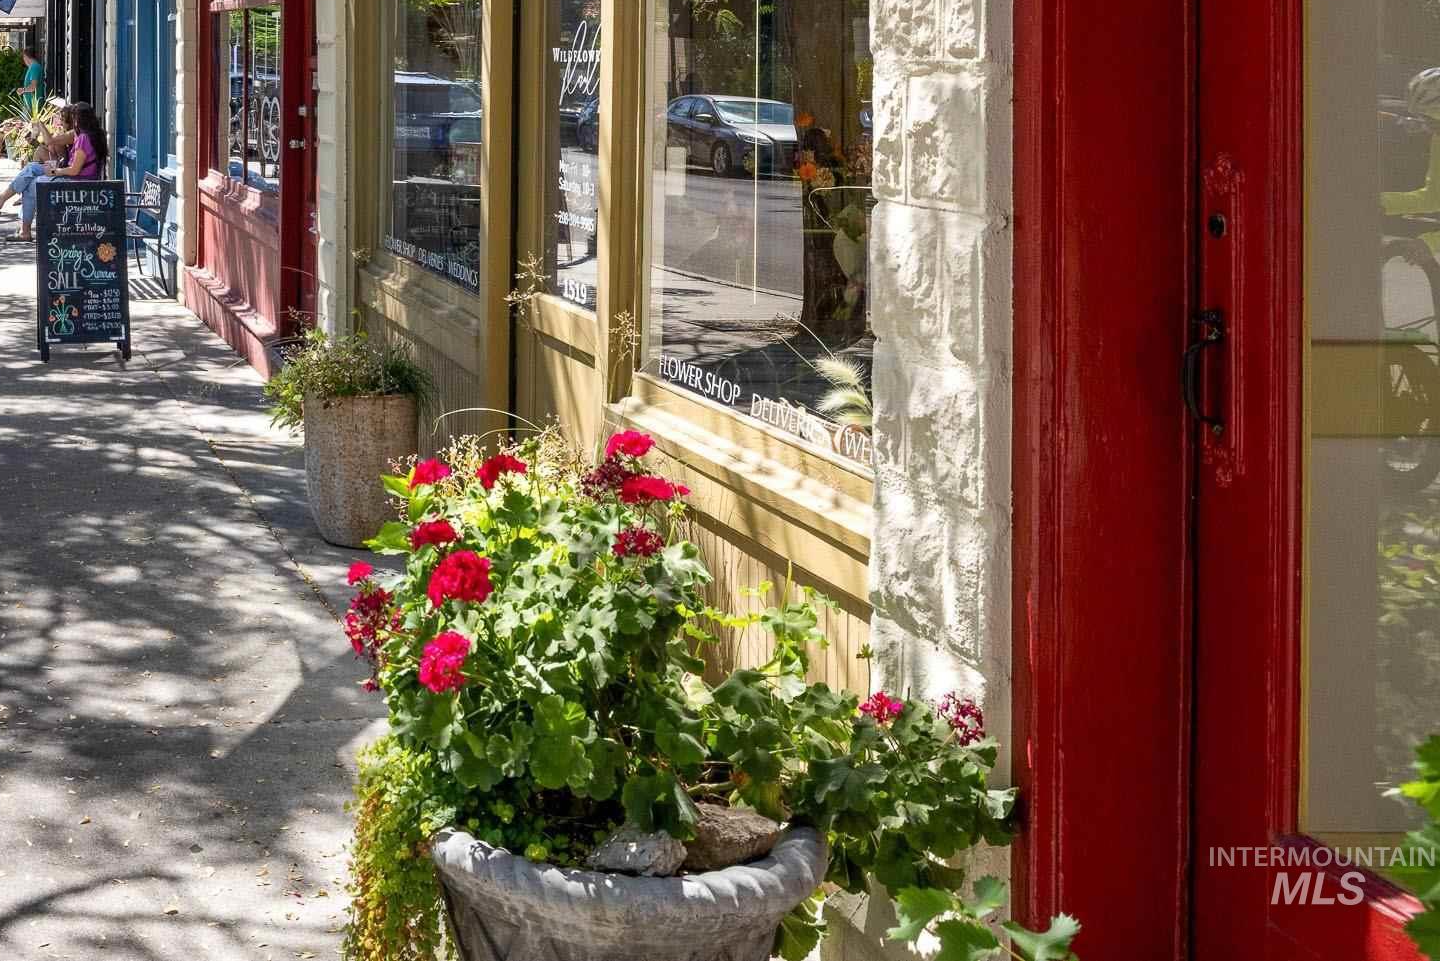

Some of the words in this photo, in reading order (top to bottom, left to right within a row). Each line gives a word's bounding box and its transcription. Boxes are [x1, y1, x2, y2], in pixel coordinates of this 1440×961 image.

[552, 47, 601, 63] WILDFLOWE
[55, 190, 88, 203] HELP
[91, 190, 109, 206] US
[55, 223, 72, 233] For
[47, 237, 83, 273] Spring
[448, 259, 479, 288] WEDDINGS
[563, 279, 587, 305] 1519
[658, 354, 704, 392] FLOWER
[704, 372, 742, 406] SHOP
